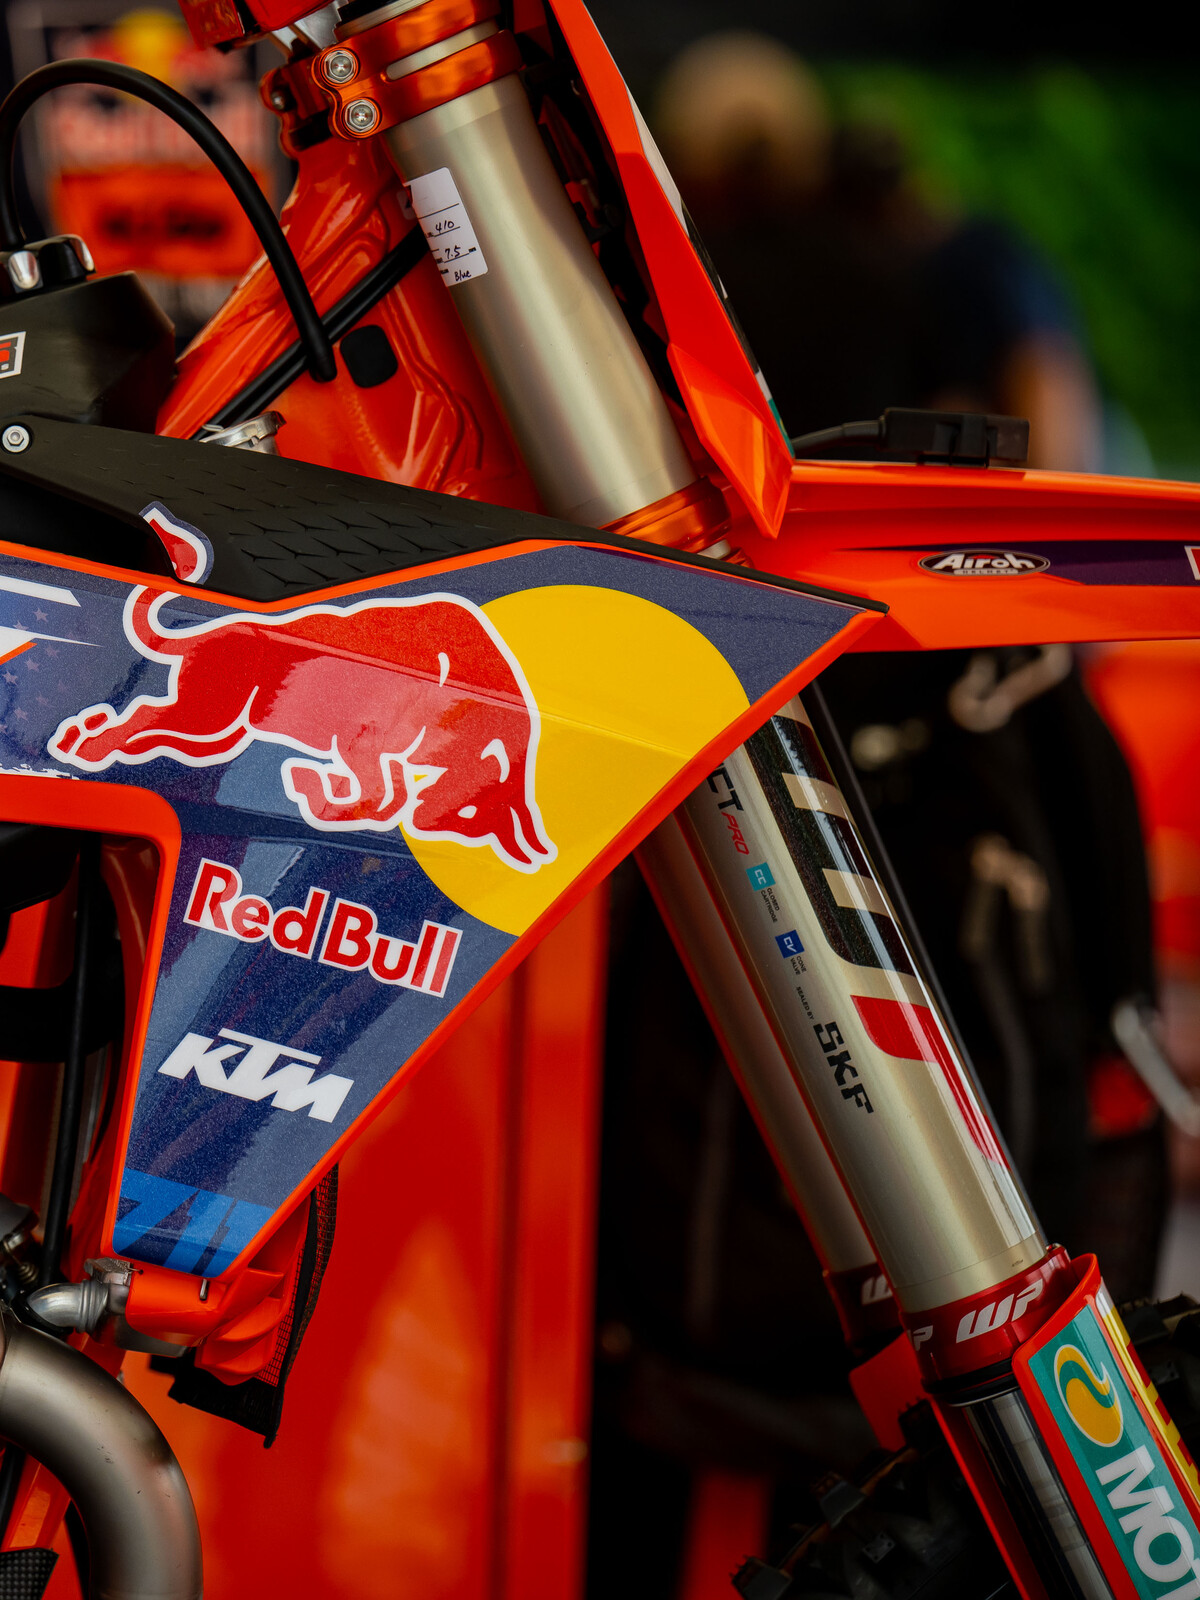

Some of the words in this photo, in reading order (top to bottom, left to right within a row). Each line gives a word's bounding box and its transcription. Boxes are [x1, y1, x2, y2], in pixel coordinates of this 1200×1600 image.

[445, 245, 461, 259] 7.5
[454, 269, 471, 281] Blue
[932, 553, 1035, 569] Airoh
[707, 762, 744, 812] CT
[721, 811, 750, 855] PRO
[760, 890, 778, 923] CARTRIDGE
[767, 887, 780, 911] CLOSED
[184, 858, 330, 959] Red
[318, 898, 463, 998] Bull
[796, 956, 807, 973] CONE
[158, 1028, 354, 1123] KTM
[813, 1021, 874, 1114] SKF
[956, 1279, 1044, 1343] WP
